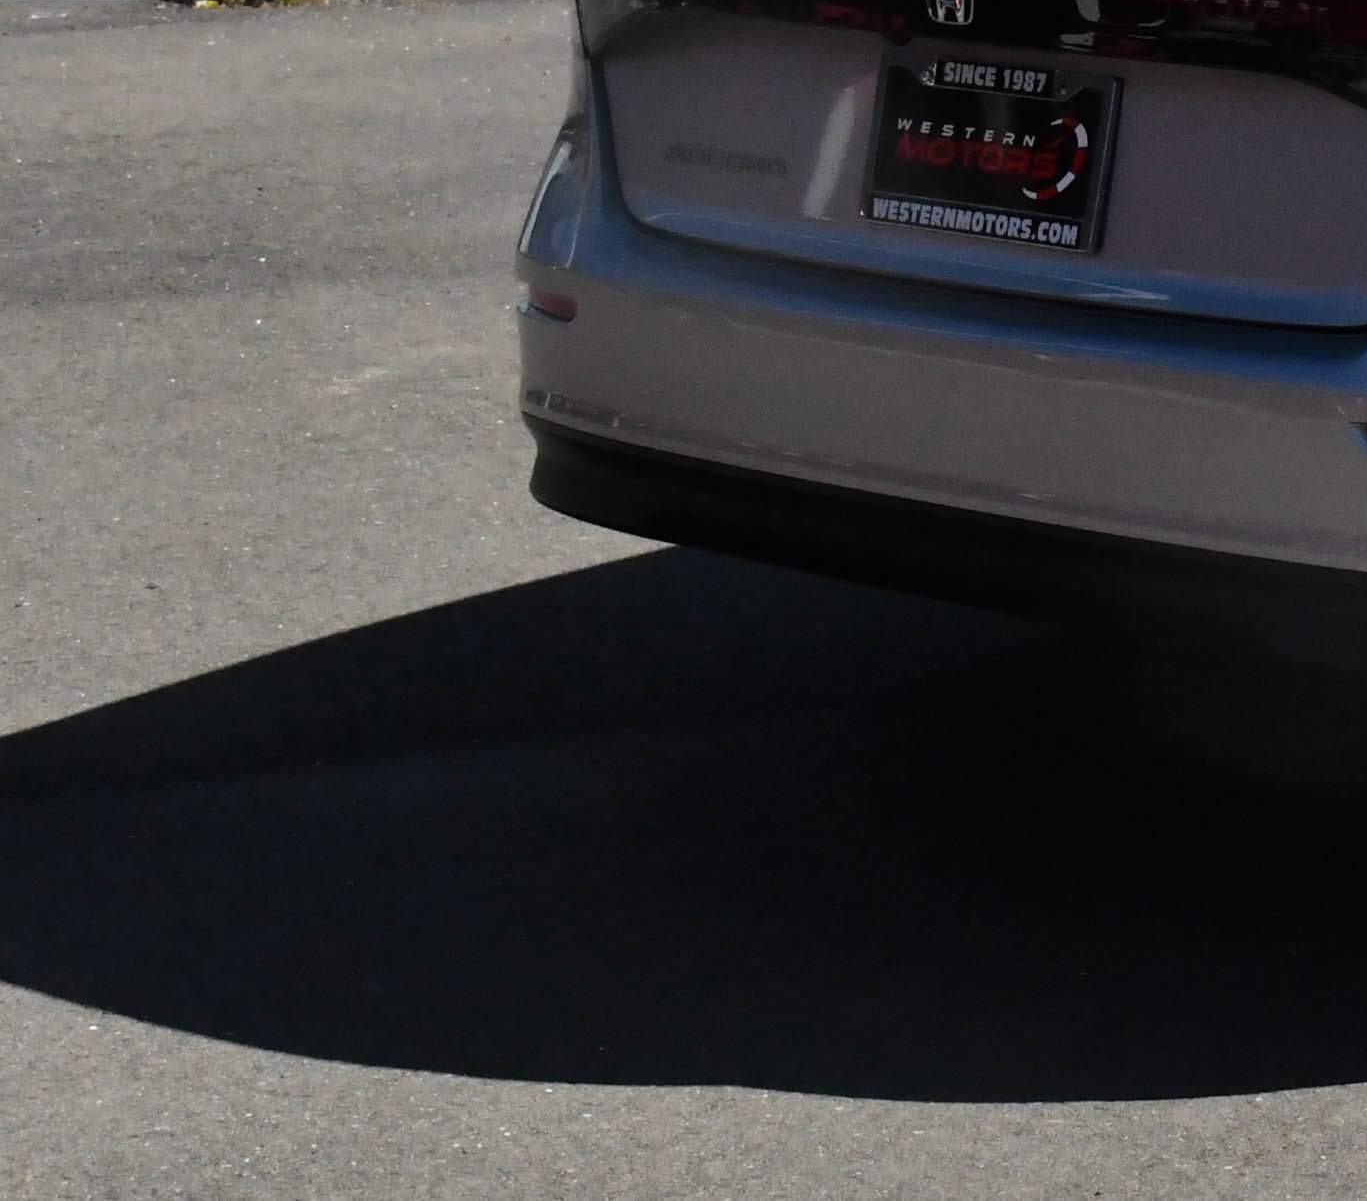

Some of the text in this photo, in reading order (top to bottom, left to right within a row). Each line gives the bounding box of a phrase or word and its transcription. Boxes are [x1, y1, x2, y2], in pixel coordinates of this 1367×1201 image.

[943, 61, 1048, 94] SINCE 1987
[897, 117, 1036, 148] WESTERN
[896, 133, 1060, 180] MOTORS
[872, 197, 1079, 247] WESTERNMOTORS.COM
